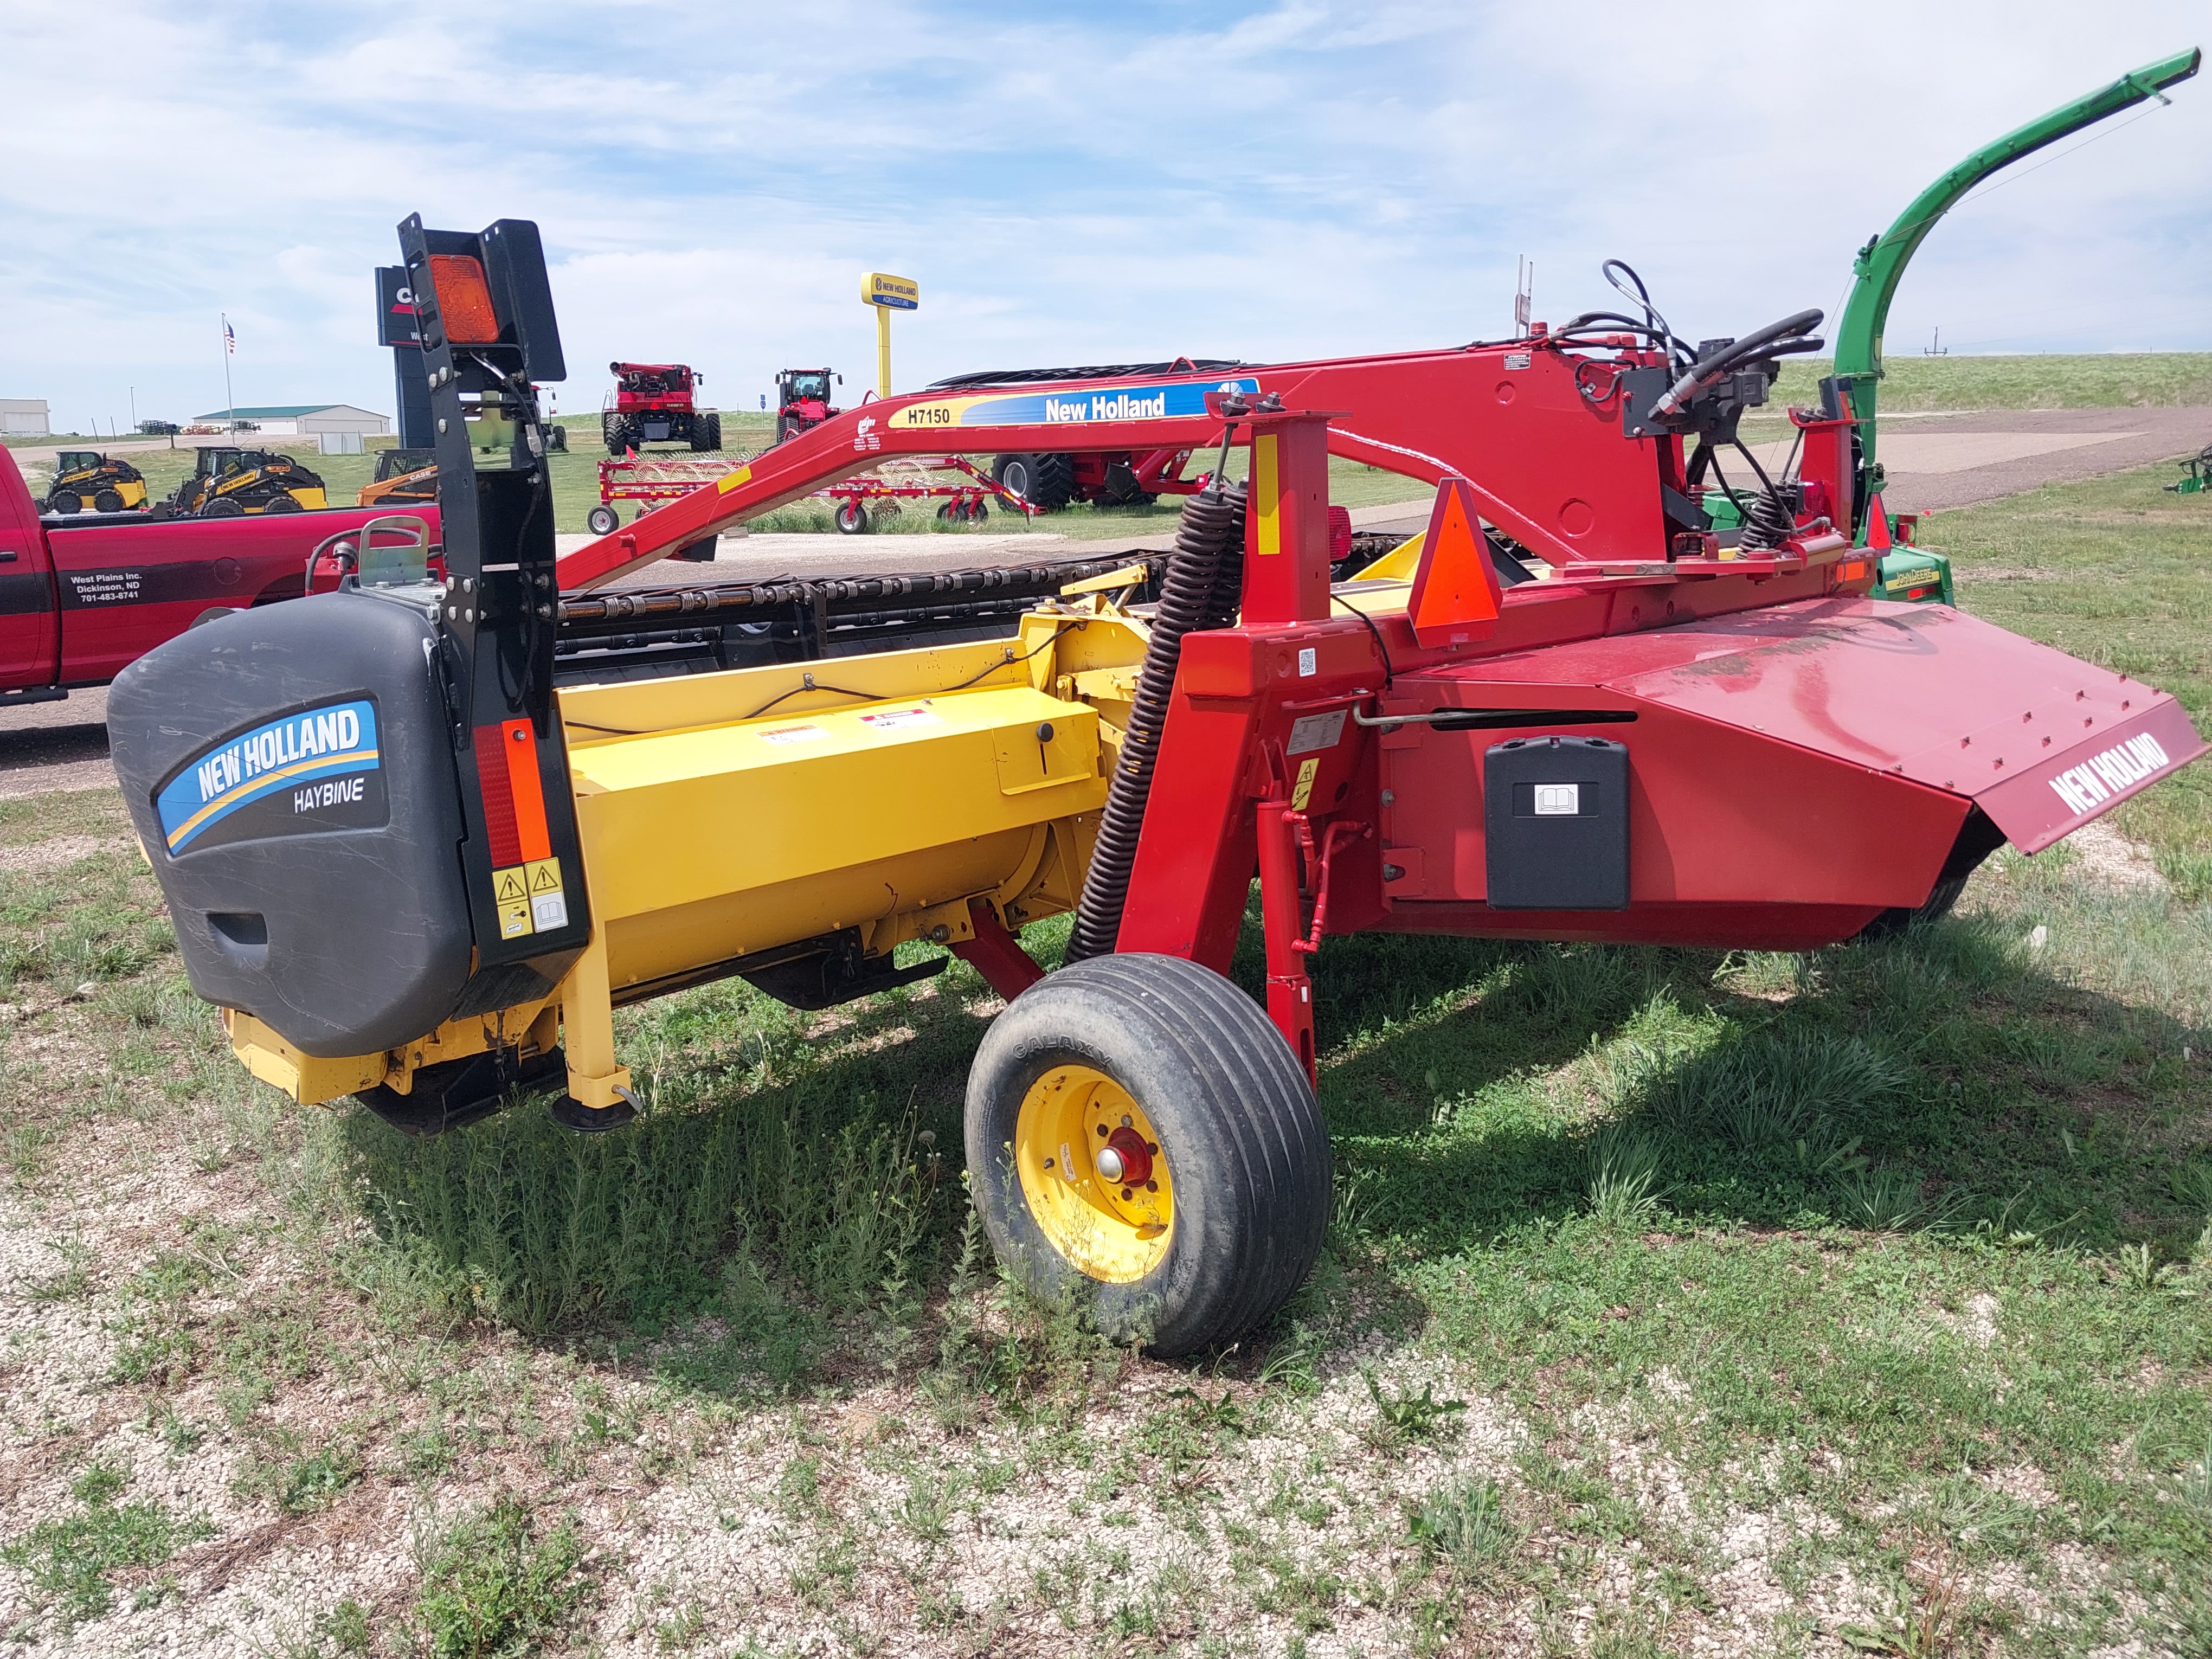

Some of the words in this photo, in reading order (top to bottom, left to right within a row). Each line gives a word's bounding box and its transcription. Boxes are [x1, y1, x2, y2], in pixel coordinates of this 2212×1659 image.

[883, 281, 894, 292] NEW
[895, 284, 916, 296] HOLLAND
[882, 296, 909, 307] AGRICULTURE
[1045, 398, 1087, 422] New
[1091, 392, 1165, 420] Holland
[908, 408, 950, 425] H7150
[234, 474, 254, 486] HOLLAND
[409, 470, 431, 481] CASE
[70, 576, 95, 584] West
[96, 574, 124, 582] Plains
[1896, 571, 1912, 586] JOHN
[1911, 568, 1932, 581] DEERE
[76, 583, 125, 594] Dickinson,
[126, 581, 140, 589] ND
[81, 590, 139, 603] 701-483-8741
[198, 745, 241, 803] NEW
[243, 709, 360, 779] HOLLAND
[2048, 762, 2111, 816] NEW
[2087, 732, 2170, 793] HOLLAND
[294, 777, 365, 814] HAYBINE
[1013, 1034, 1113, 1066] GALAXY
